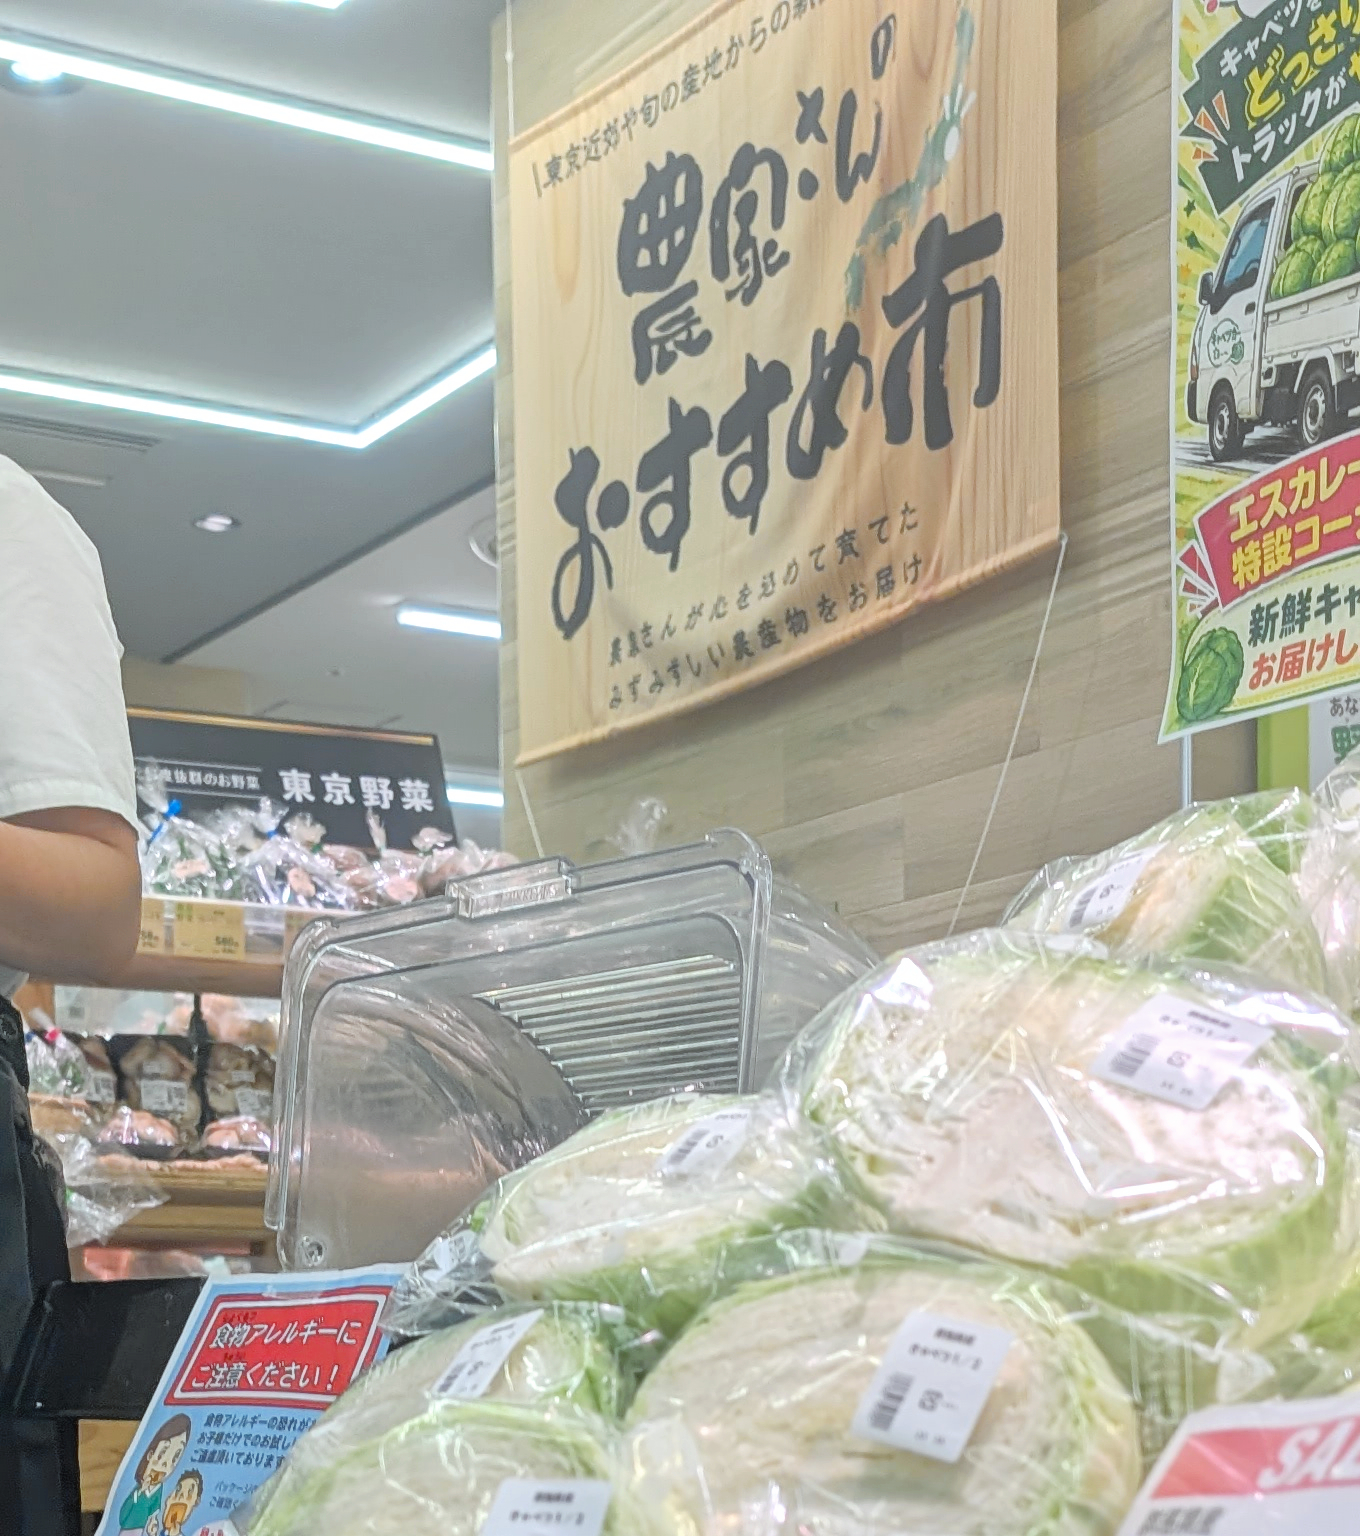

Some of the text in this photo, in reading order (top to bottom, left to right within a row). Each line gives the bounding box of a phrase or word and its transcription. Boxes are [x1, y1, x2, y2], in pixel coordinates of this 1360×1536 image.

[616, 14, 898, 386] 農家さんの
[551, 212, 1004, 641] おすすめ市
[277, 768, 436, 814] 東京野菜
[208, 1317, 362, 1349] 食物アレルギーに
